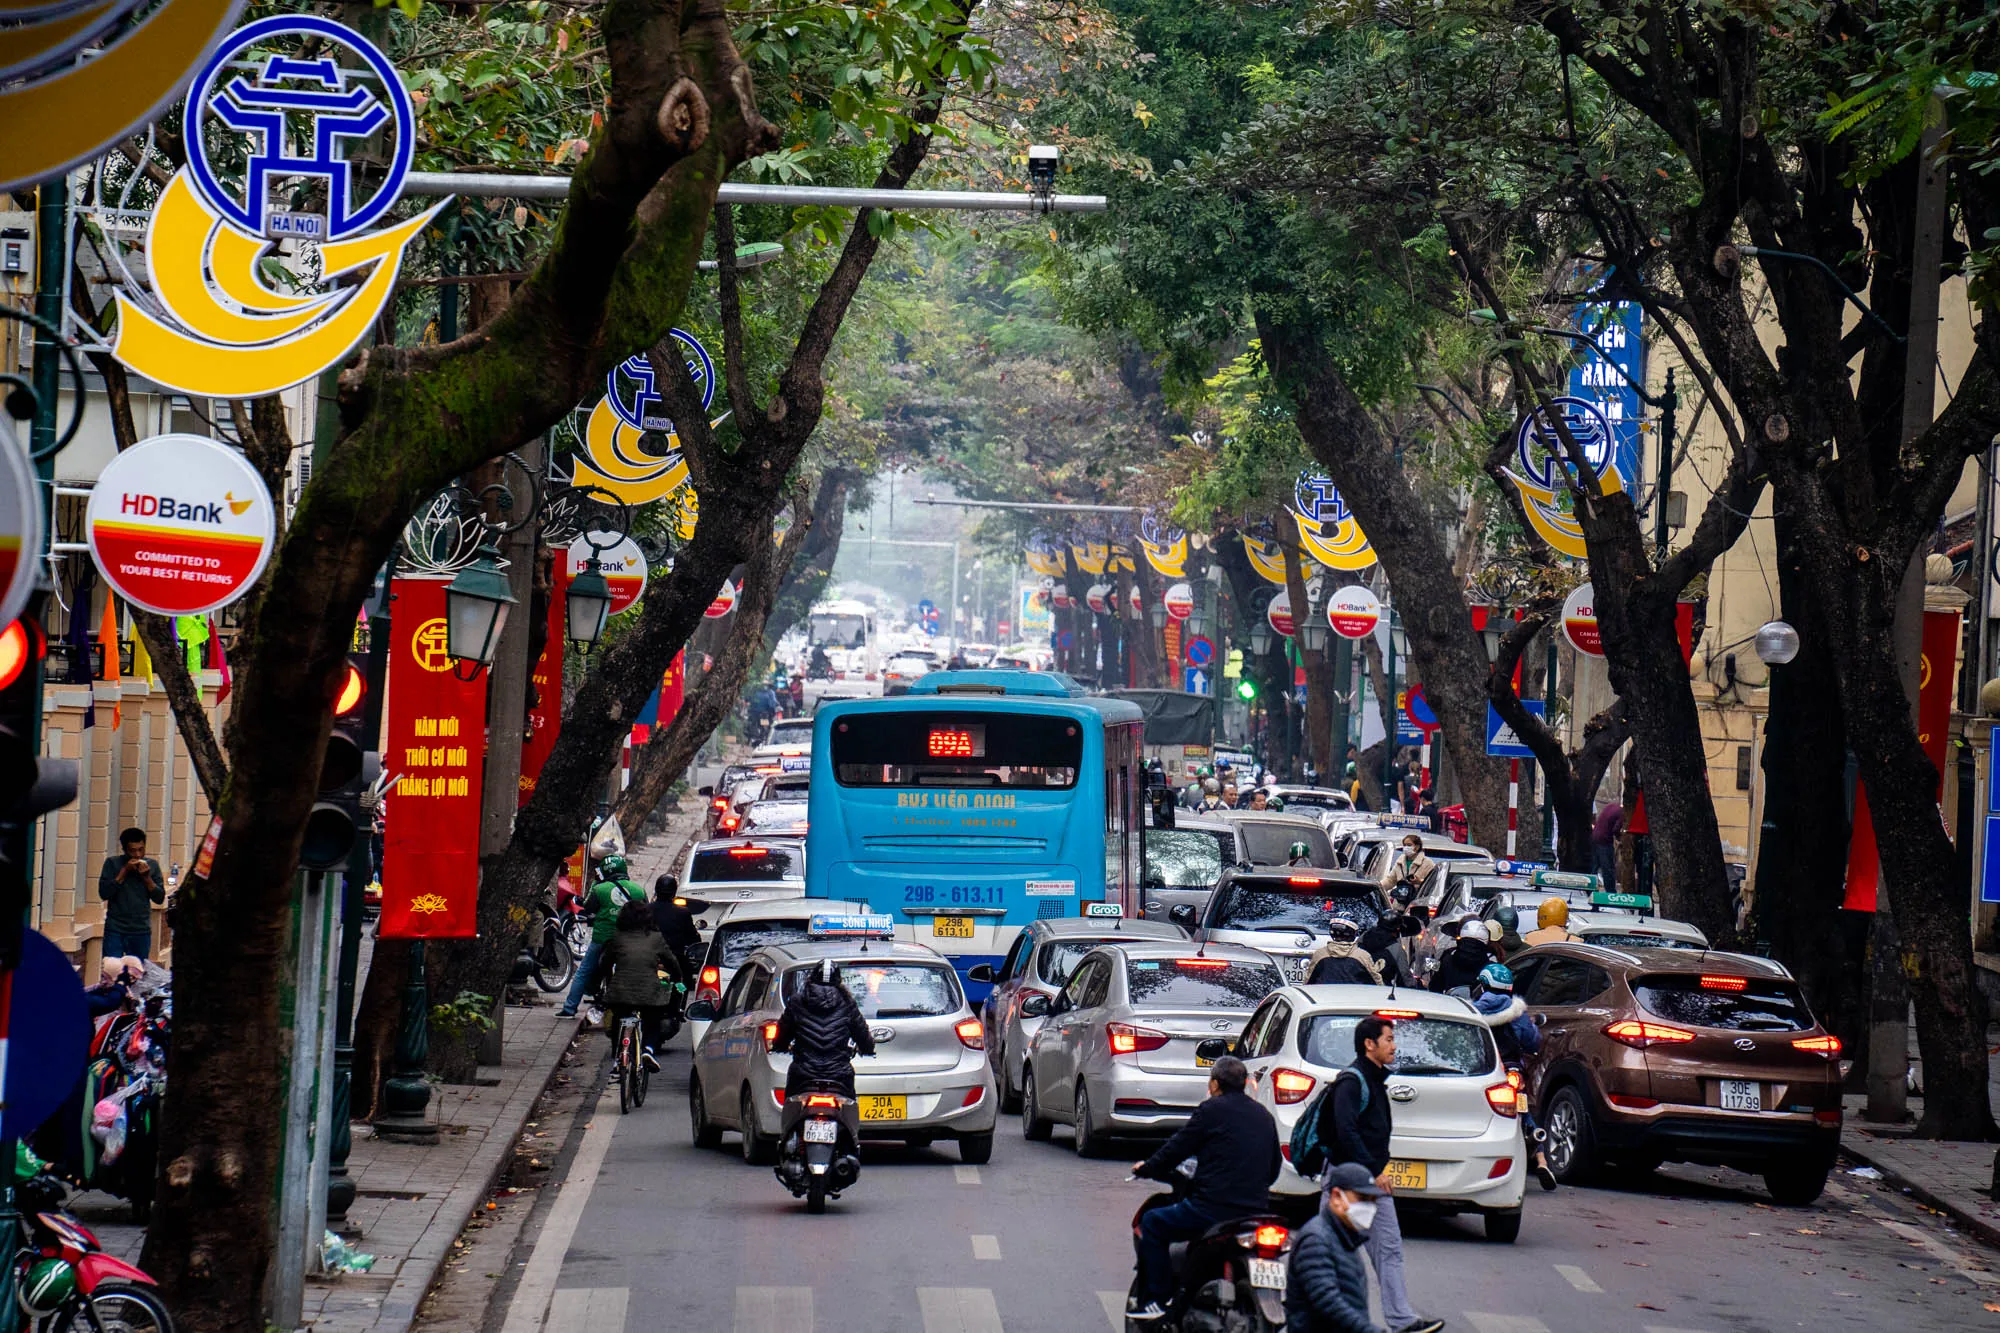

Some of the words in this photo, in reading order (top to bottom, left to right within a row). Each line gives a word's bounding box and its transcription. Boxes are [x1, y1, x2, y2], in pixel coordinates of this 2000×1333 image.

[121, 493, 223, 524] HDBank
[135, 551, 203, 566] COMMITTED
[205, 558, 221, 568] TO
[576, 560, 624, 572] Hank
[120, 565, 151, 576] YOUR
[153, 569, 180, 580] BEST
[181, 571, 232, 585] RETURNS
[1337, 602, 1367, 612] HDBank
[415, 716, 437, 737] NĂM
[439, 716, 460, 737] MỚI
[930, 731, 973, 756] 09A
[405, 745, 429, 766] THỜI
[431, 746, 445, 766] CƠ
[447, 746, 467, 766] MỚI
[397, 773, 430, 797] THẮNG
[431, 777, 446, 799] LỢI
[448, 775, 469, 797] MỚI
[897, 793, 929, 808] BUS
[973, 794, 1016, 809] NINH
[904, 885, 935, 902] 29B
[951, 886, 1004, 903] 613.11
[1608, 893, 1636, 903] Grab
[1093, 905, 1119, 914] Grab
[842, 914, 866, 928] SÔNG
[937, 927, 969, 937] 613.11
[1730, 1081, 1752, 1095] 30E
[872, 1096, 893, 1107] 30A
[1724, 1095, 1759, 1109] 117.99
[864, 1108, 902, 1120] 424.50
[1389, 1161, 1412, 1174] 30F
